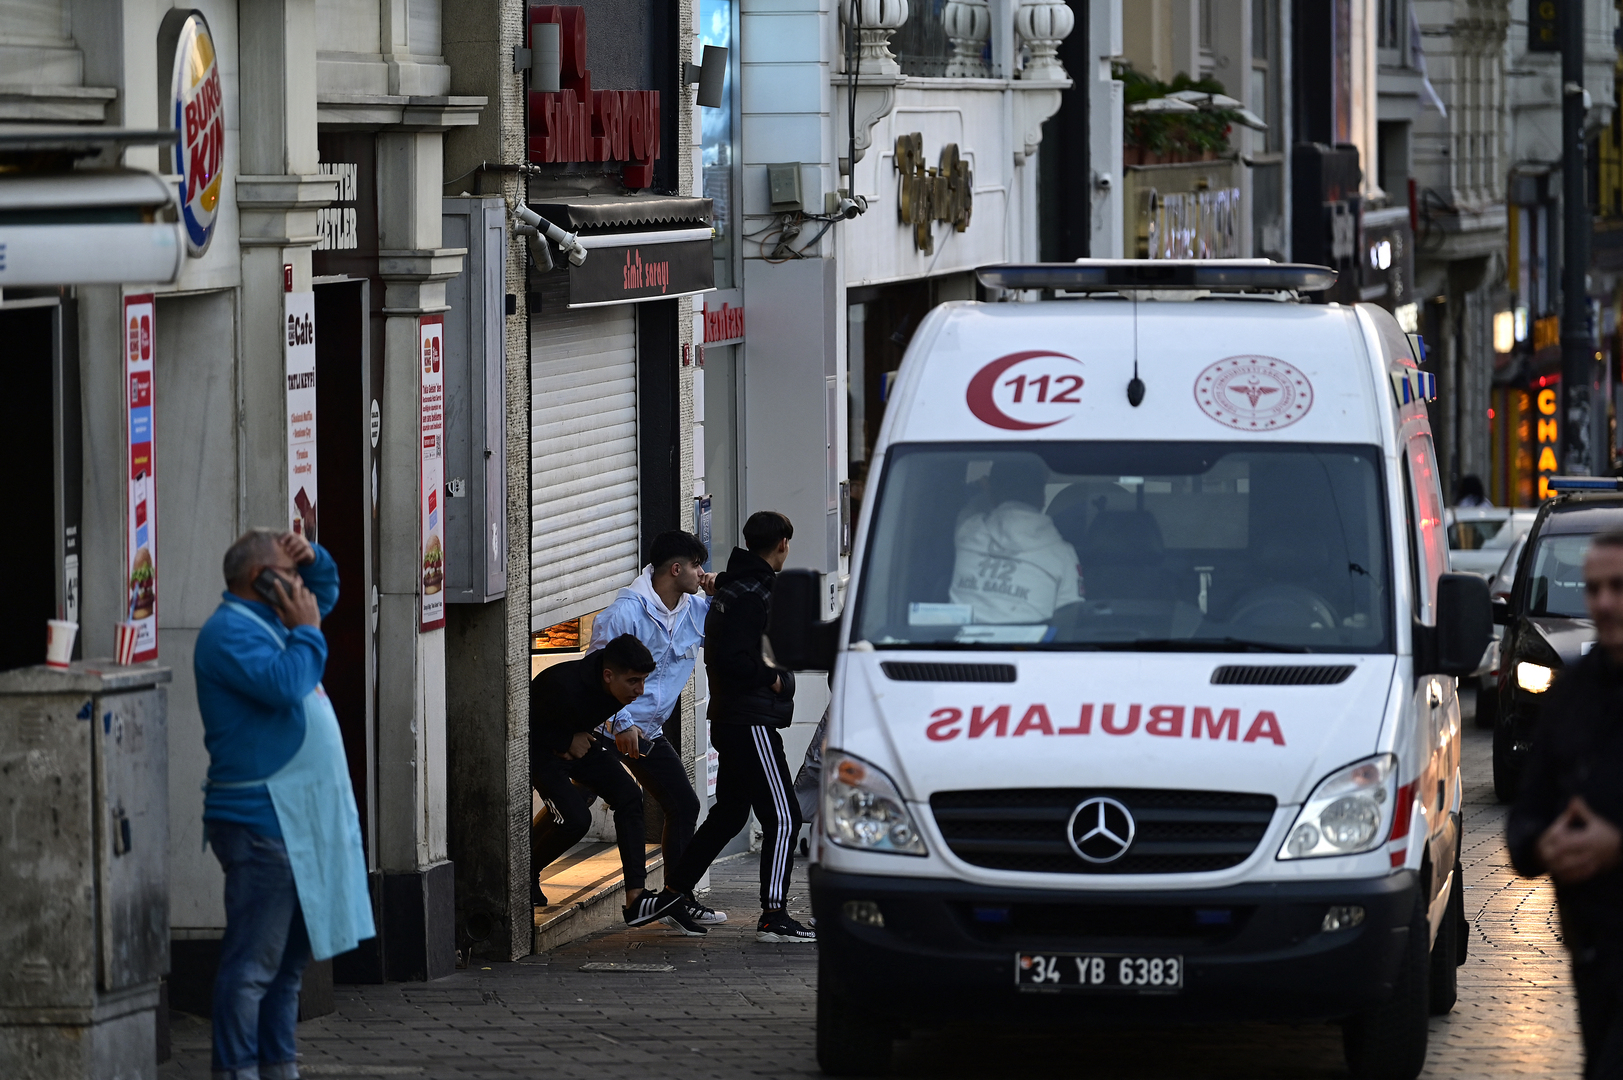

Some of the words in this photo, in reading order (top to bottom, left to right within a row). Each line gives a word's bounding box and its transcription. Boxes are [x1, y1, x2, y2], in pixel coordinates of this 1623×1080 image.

[623, 248, 643, 290] simit
[645, 261, 669, 294] sarayı
[295, 312, 313, 346] Cafe
[1004, 374, 1085, 404] 112
[978, 558, 1018, 582] 112
[1031, 955, 1061, 984] 34
[1075, 956, 1106, 985] YB
[1119, 957, 1179, 986] 6383
